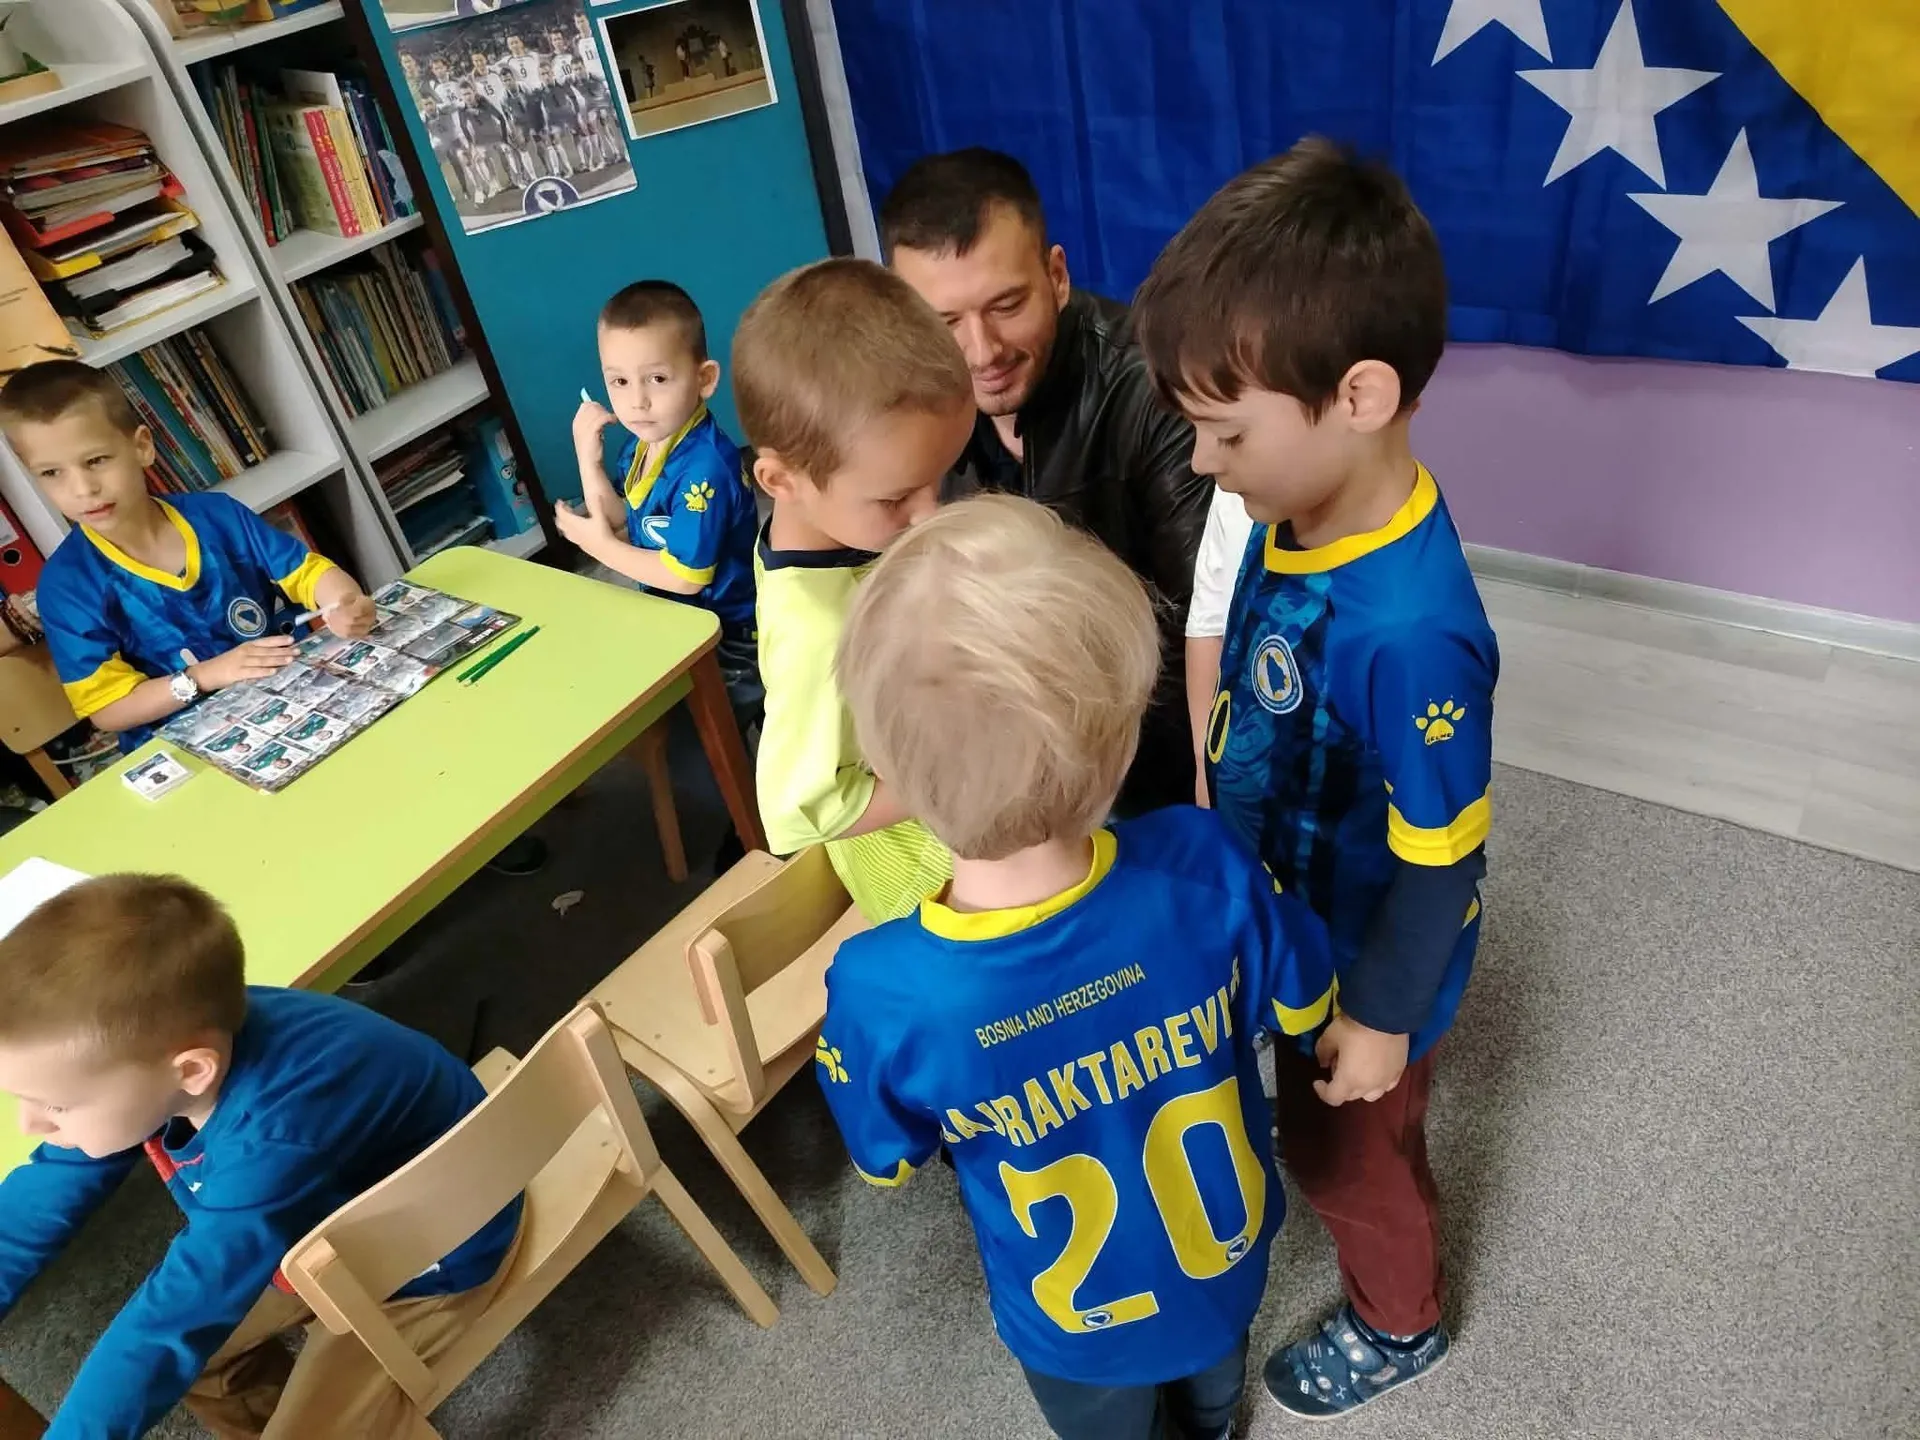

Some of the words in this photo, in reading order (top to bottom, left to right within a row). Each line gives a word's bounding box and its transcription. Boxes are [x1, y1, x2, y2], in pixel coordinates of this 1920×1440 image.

[561, 64, 573, 76] 10
[975, 1014, 1028, 1049] BOSNIA
[1025, 1002, 1055, 1031] AND
[1053, 962, 1146, 1018] HERZEGOVINA
[998, 1076, 1266, 1333] 20
